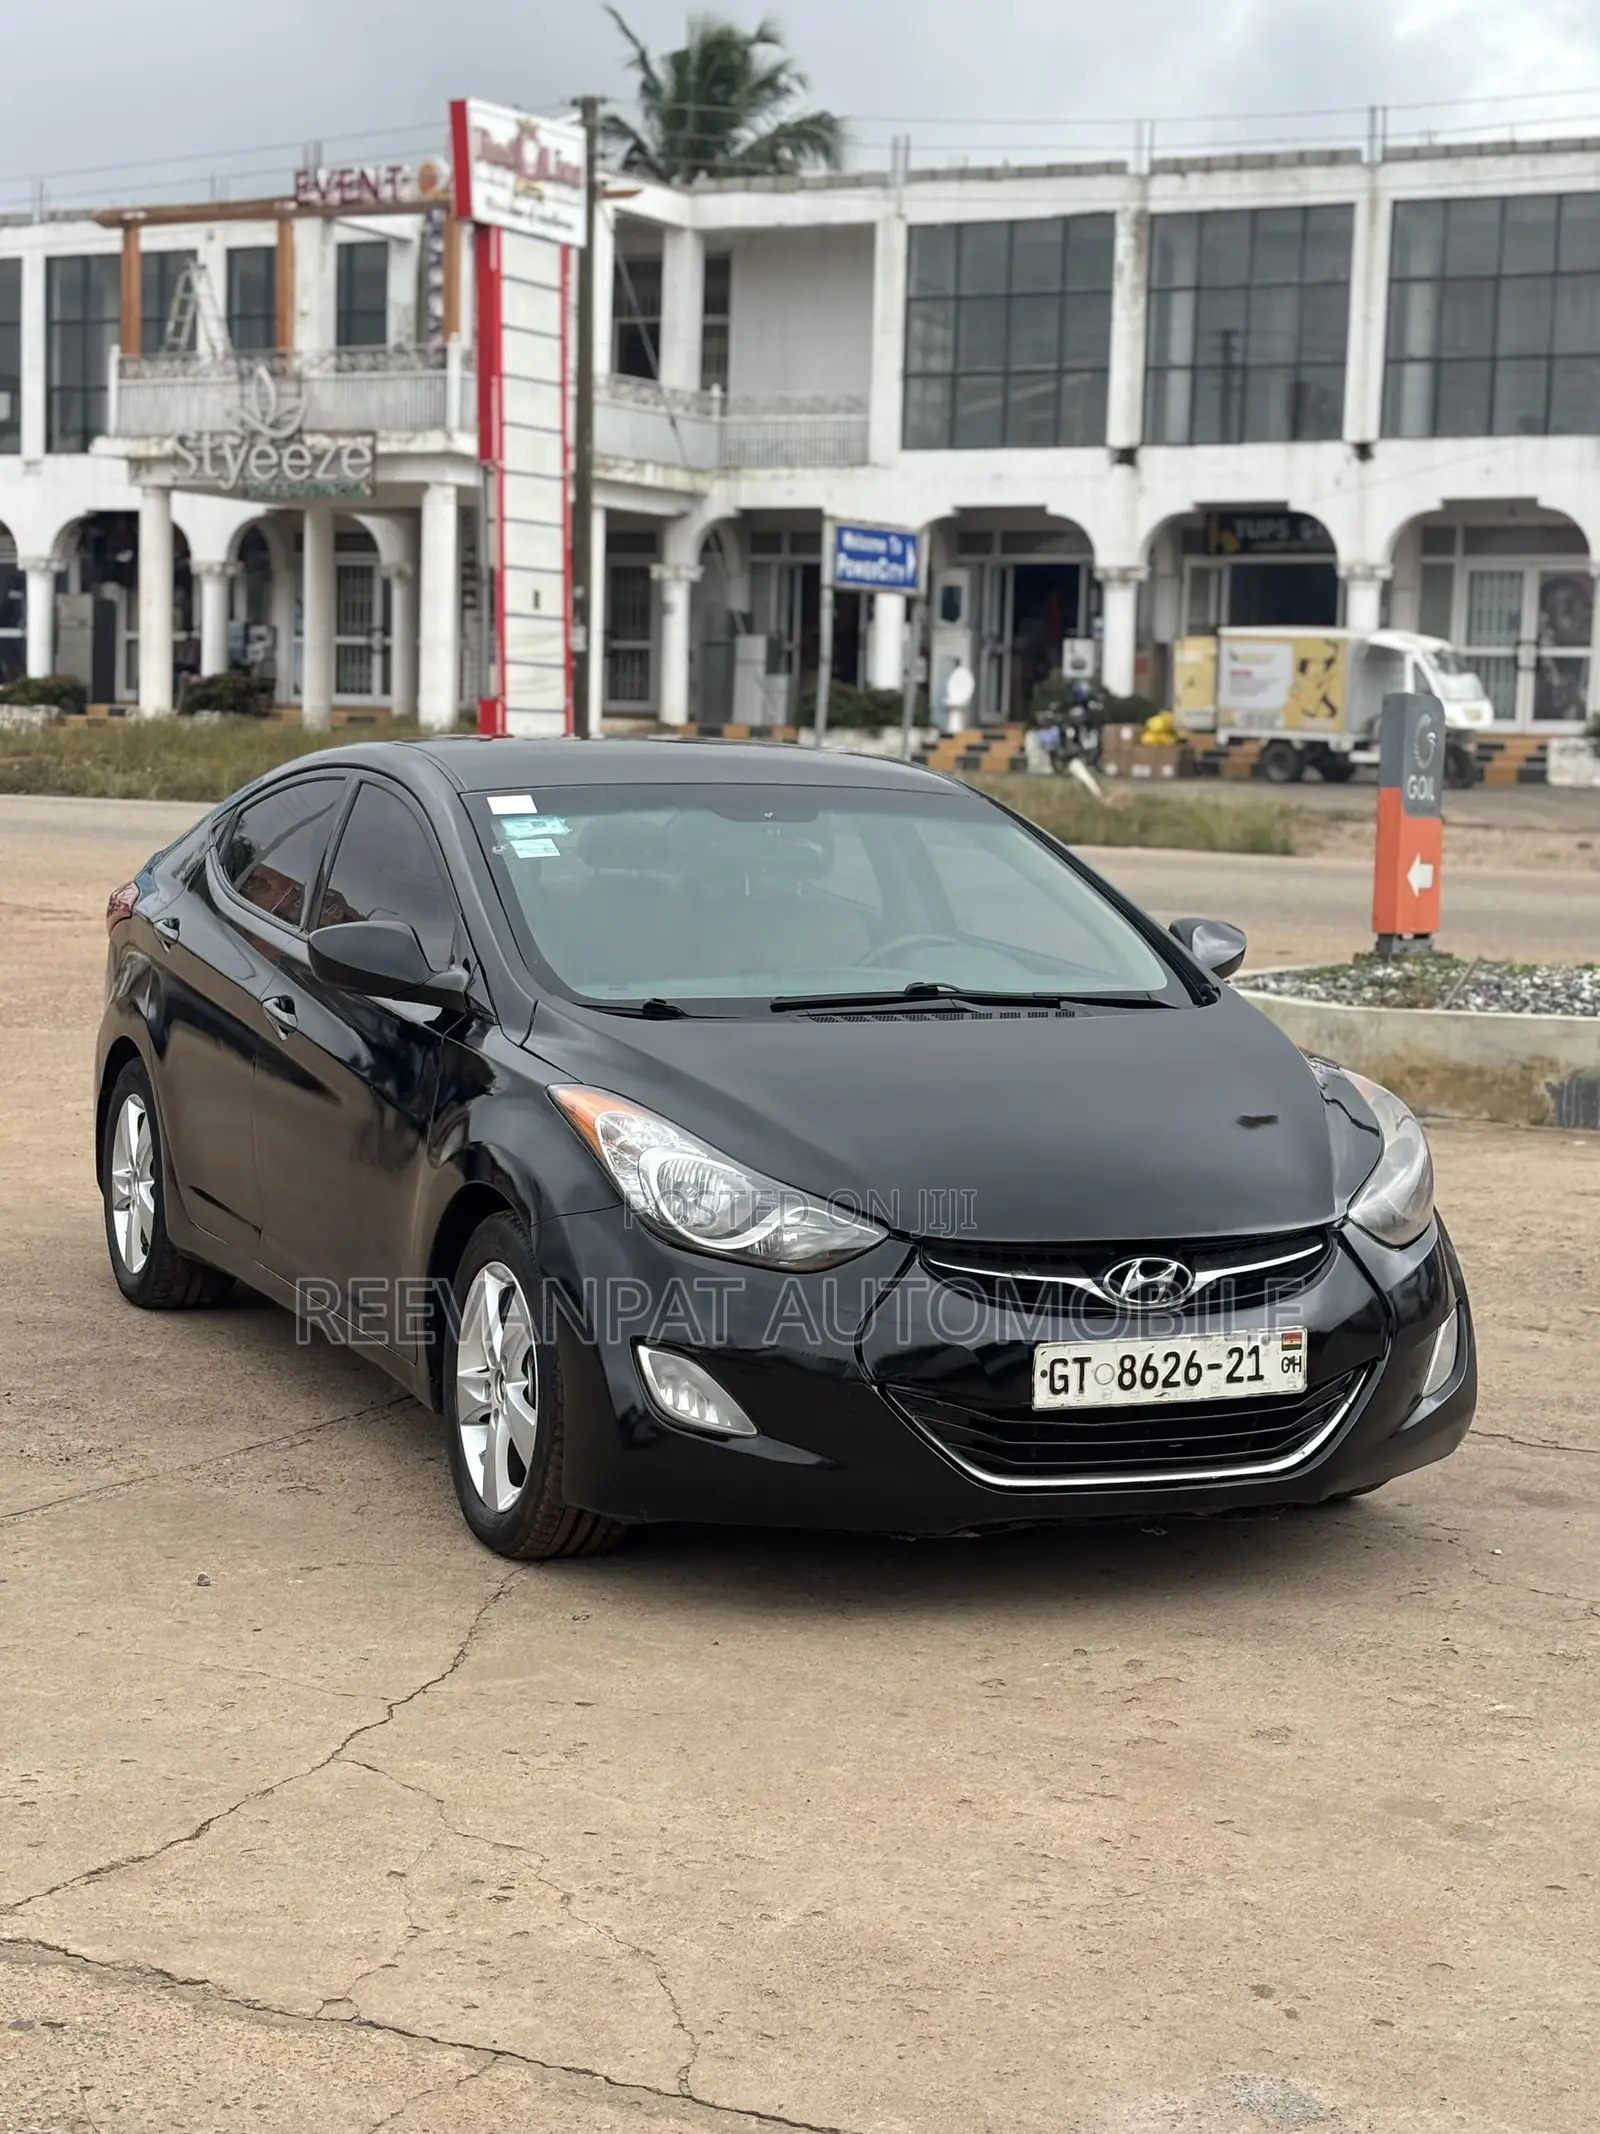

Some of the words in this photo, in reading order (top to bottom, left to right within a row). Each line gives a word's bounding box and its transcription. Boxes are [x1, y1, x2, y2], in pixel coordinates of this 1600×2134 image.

[171, 430, 374, 490] Styeeze
[1407, 774, 1436, 801] GOIL
[1049, 1356, 1092, 1395] GT
[1117, 1345, 1265, 1392] 8626-21
[1281, 1354, 1303, 1374] GH
